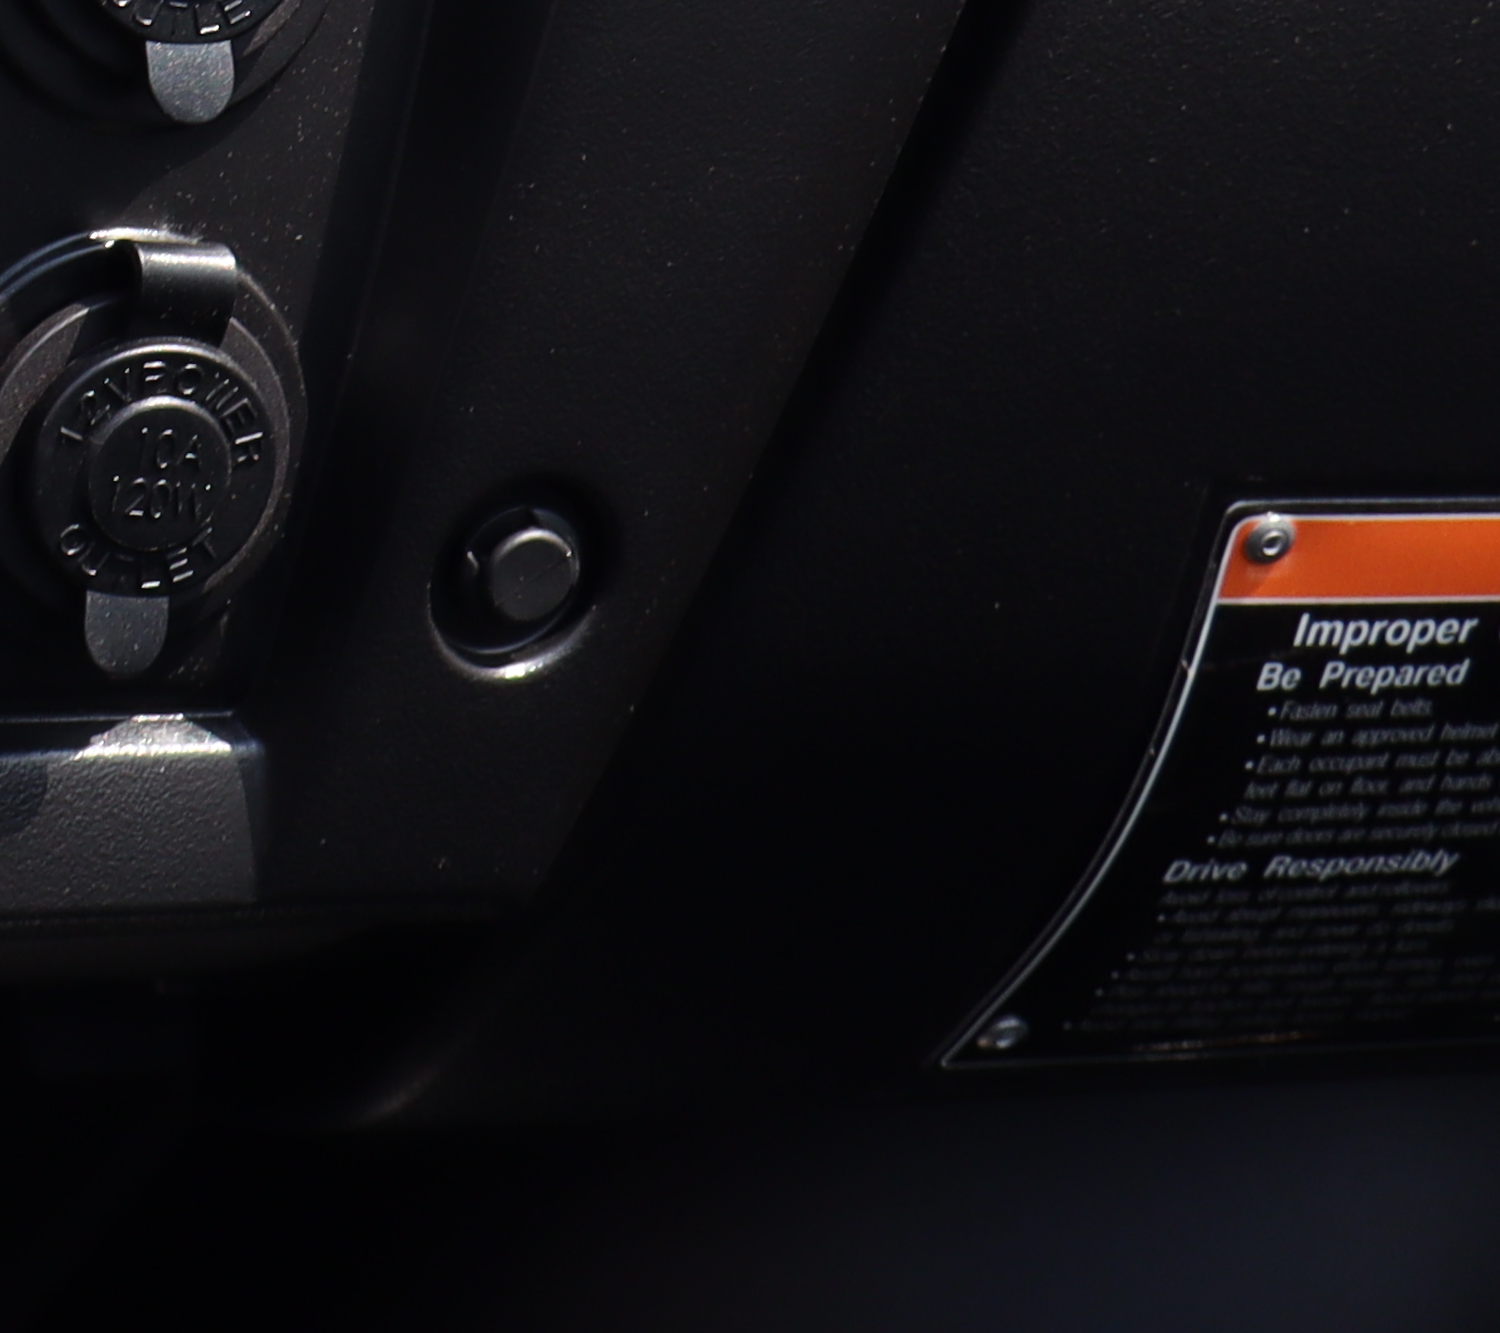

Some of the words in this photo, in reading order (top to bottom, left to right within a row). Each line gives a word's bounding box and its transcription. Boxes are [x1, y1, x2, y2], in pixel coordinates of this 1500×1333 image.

[138, 426, 203, 471] 10A
[110, 474, 214, 522] 120W
[57, 522, 220, 590] OUTLET
[1293, 612, 1479, 655] Improper
[1256, 662, 1301, 691] Be
[1319, 658, 1471, 695] Prepared
[1164, 858, 1248, 884] Drive
[1263, 848, 1461, 883] Responsibly
